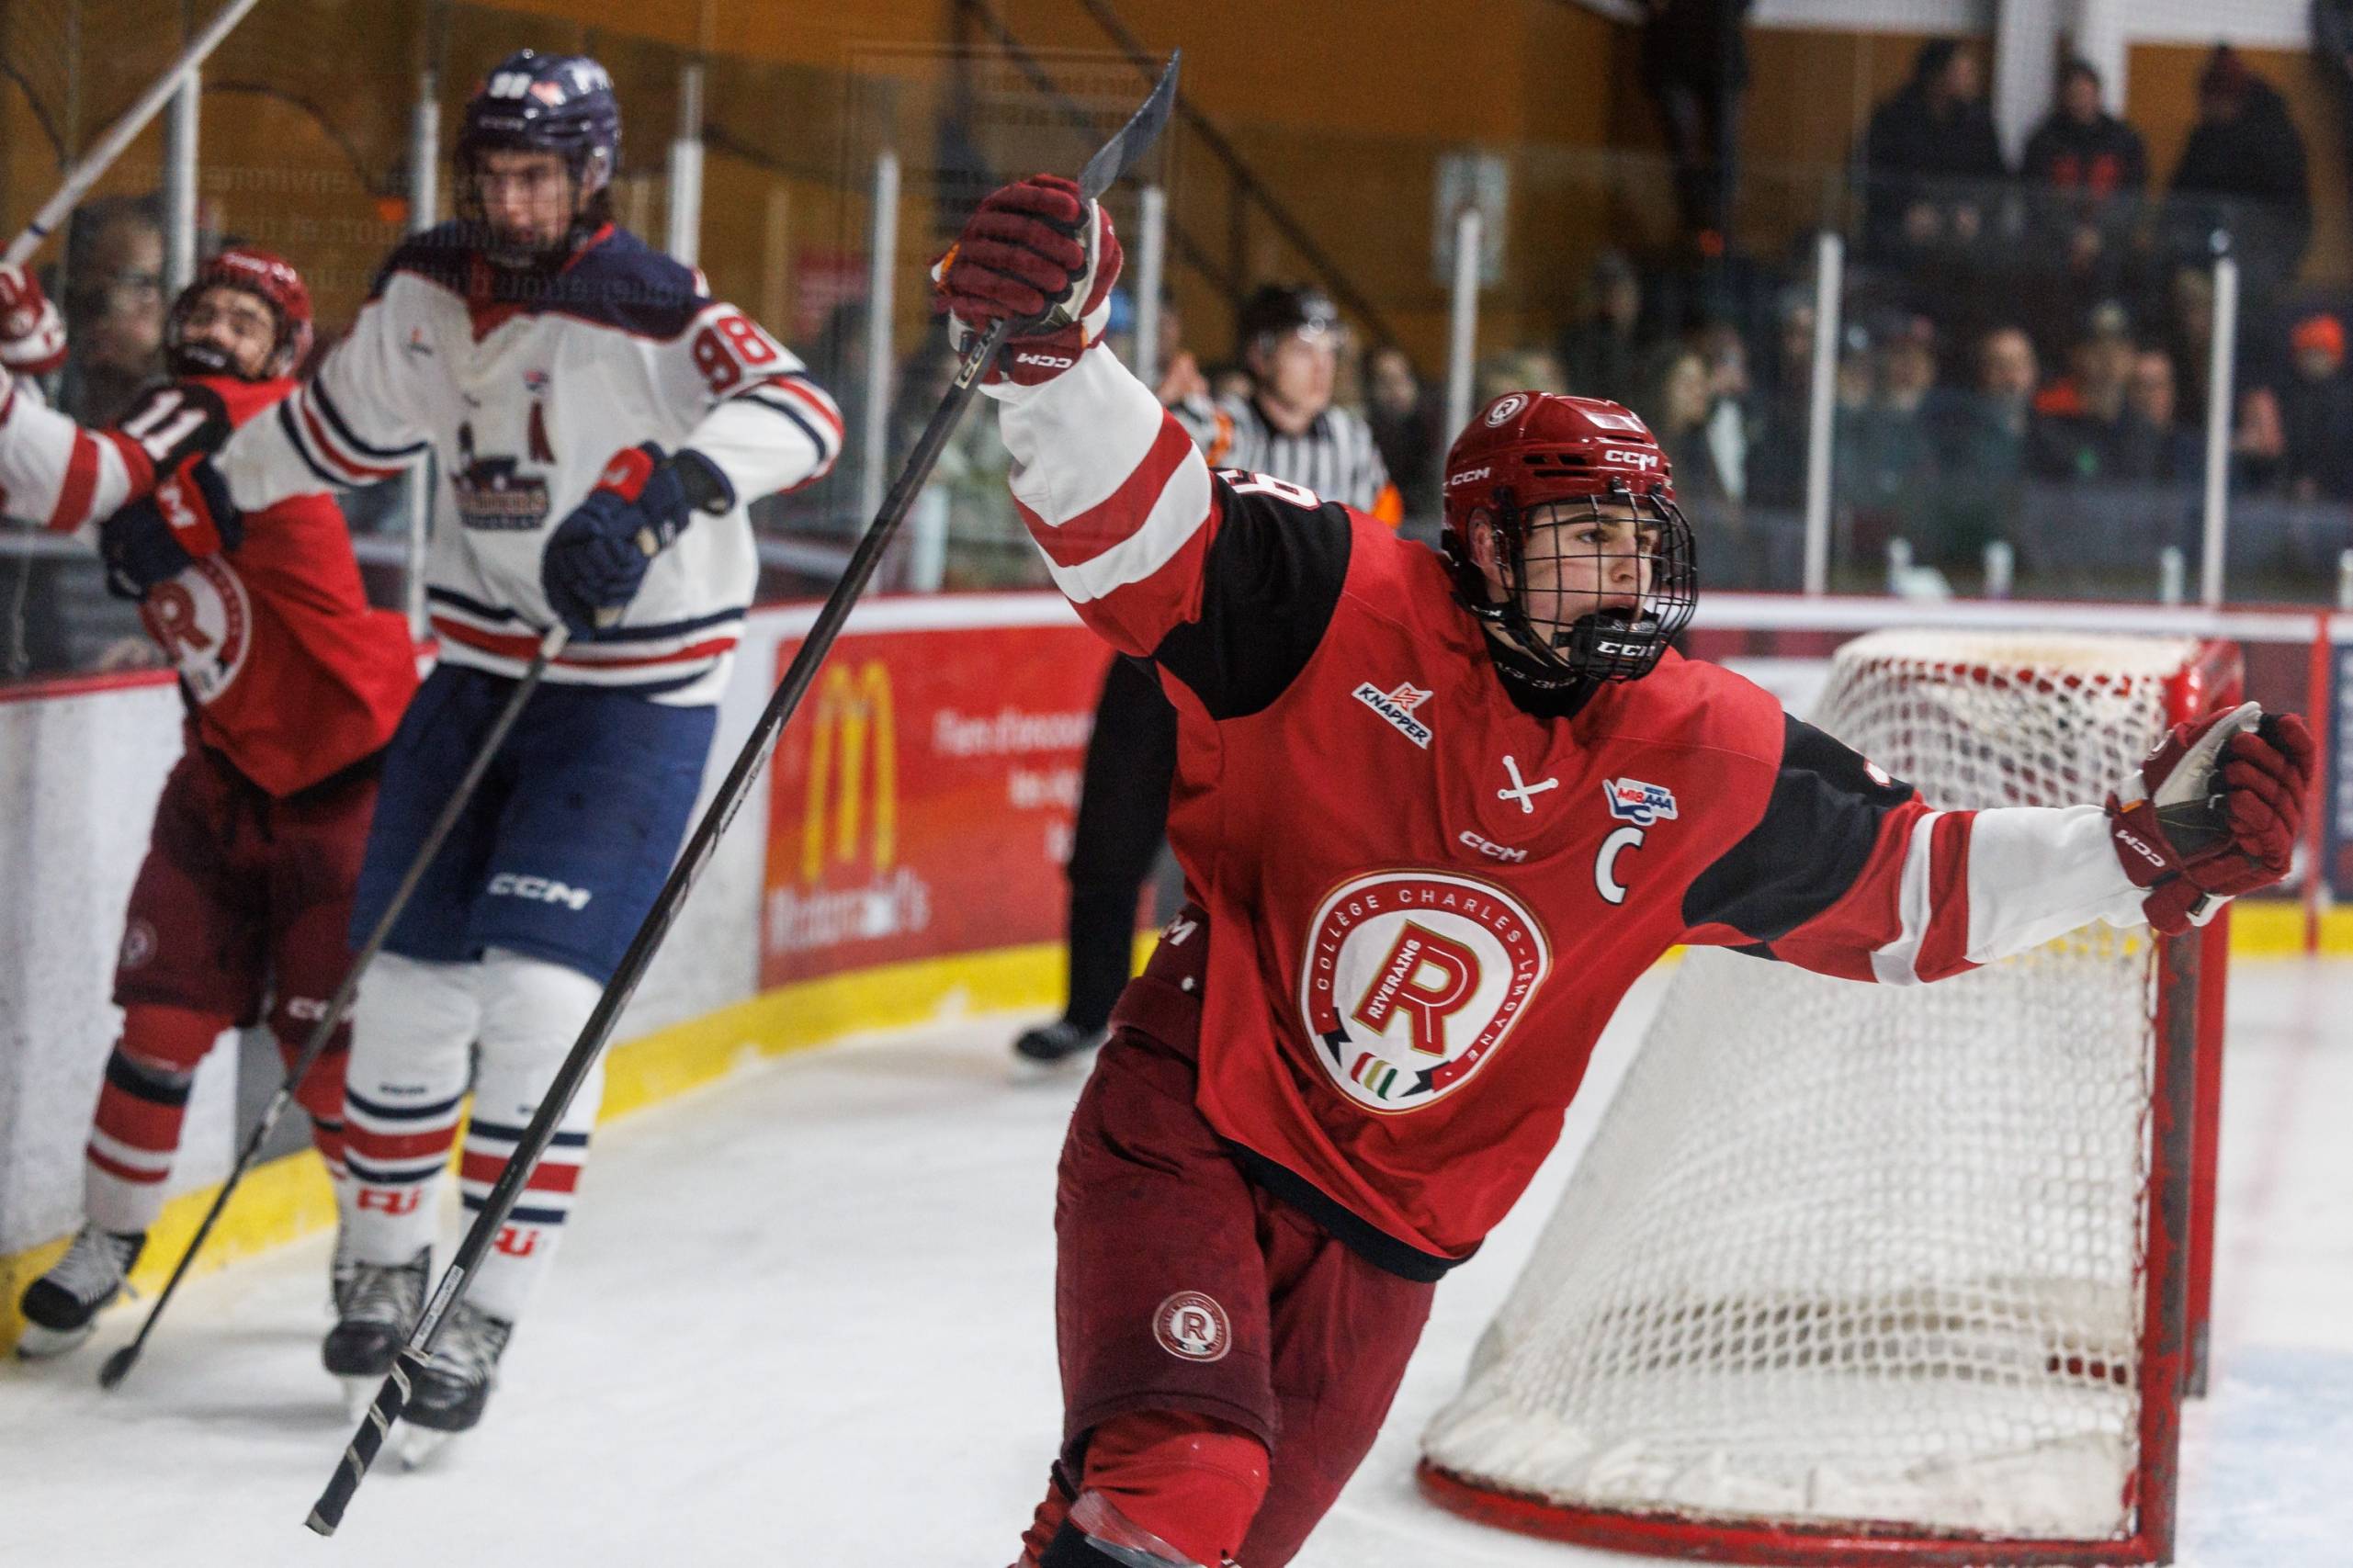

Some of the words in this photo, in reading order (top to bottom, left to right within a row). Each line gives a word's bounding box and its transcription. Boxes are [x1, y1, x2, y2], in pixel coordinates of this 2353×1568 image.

[694, 315, 776, 395] 98
[1016, 353, 1073, 369] CCM
[123, 389, 208, 461] 11
[1451, 467, 1491, 486] CCM
[1605, 449, 1658, 471] CCM
[1358, 686, 1430, 743] KNAPPER
[1458, 829, 1529, 863] CCM
[1594, 825, 1646, 906] C
[2115, 829, 2166, 868] CCM
[486, 873, 593, 911] CCM
[1317, 893, 1380, 991] COLLÈGE
[1351, 918, 1484, 1058] R
[1367, 938, 1423, 1021] RIVERAINS
[1182, 1311, 1207, 1341] R
